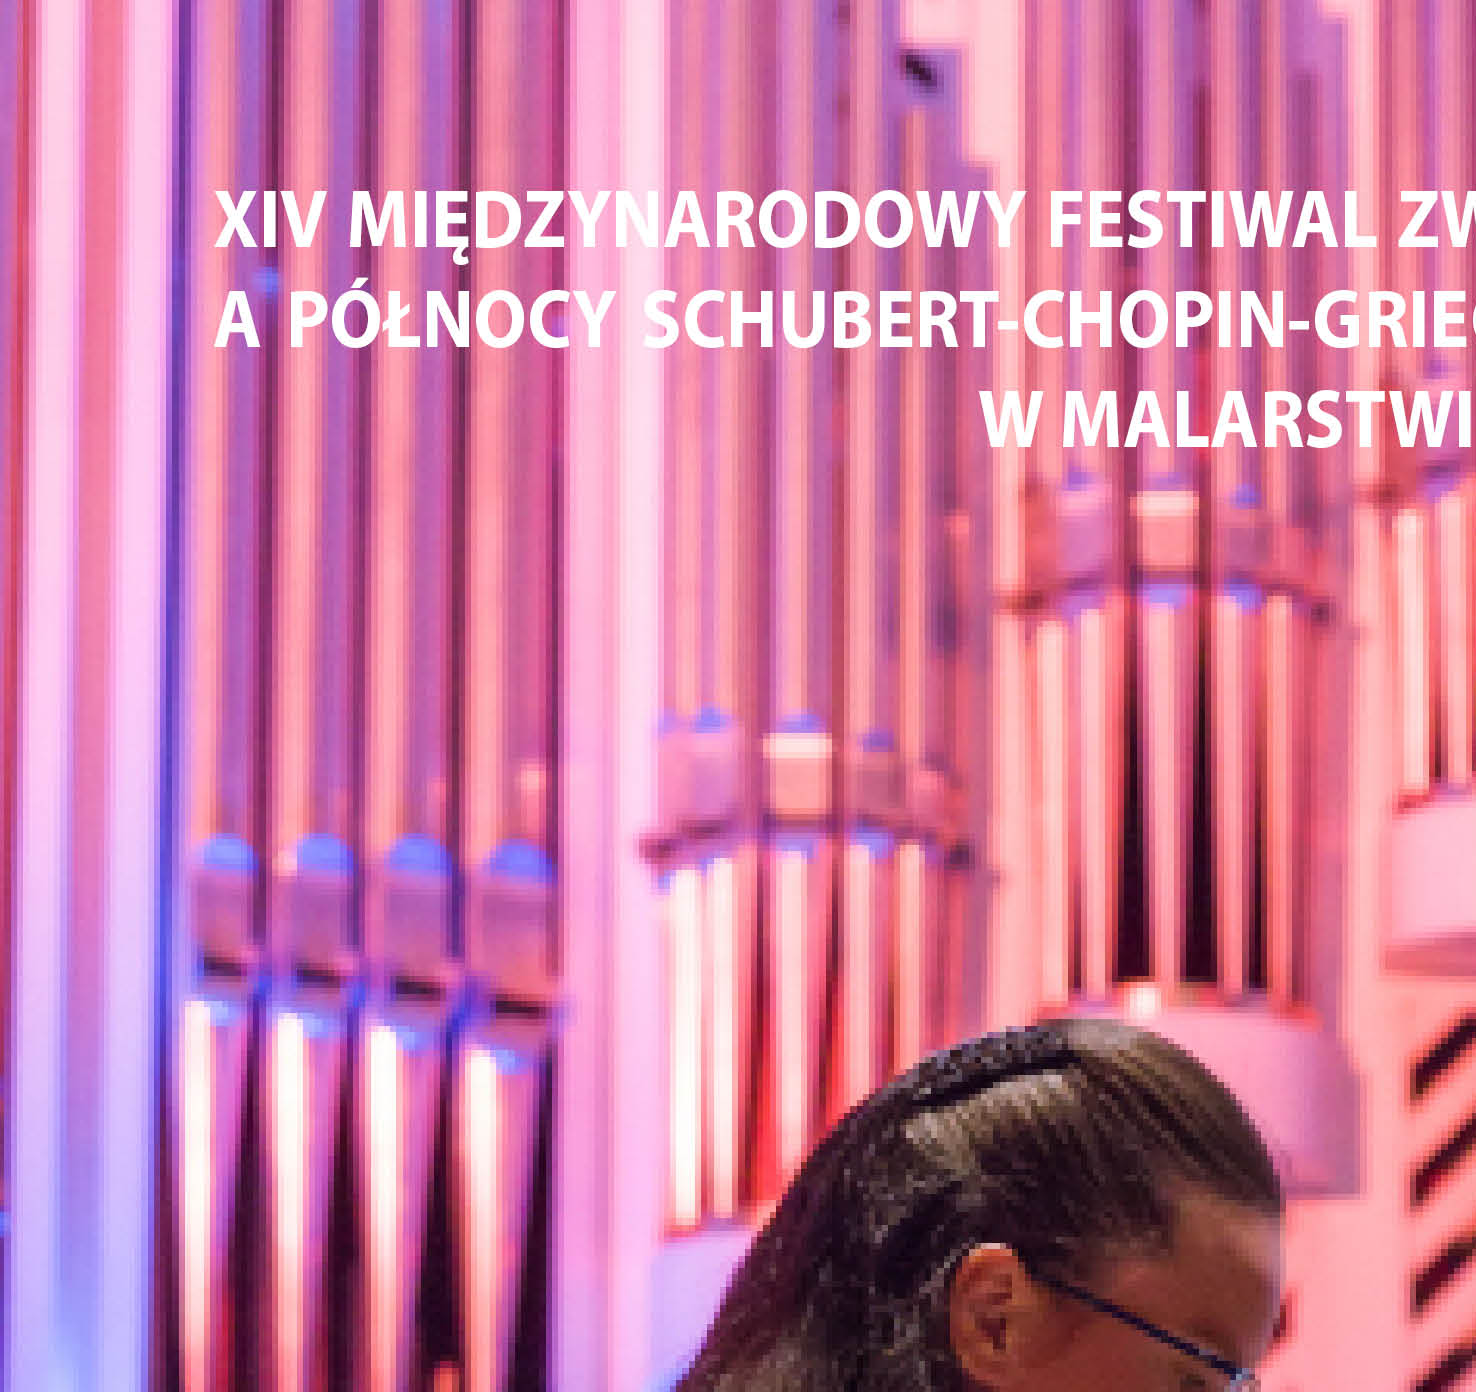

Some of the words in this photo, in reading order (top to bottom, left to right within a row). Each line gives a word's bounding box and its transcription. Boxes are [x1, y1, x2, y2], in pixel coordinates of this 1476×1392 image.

[215, 190, 327, 248] XIV
[350, 189, 1026, 266] MIĘDZYNARODOWY
[1050, 189, 1377, 249] FESTIWAL
[214, 290, 260, 348] A
[290, 277, 617, 349] PÓŁNOCY
[979, 390, 1044, 448] W
